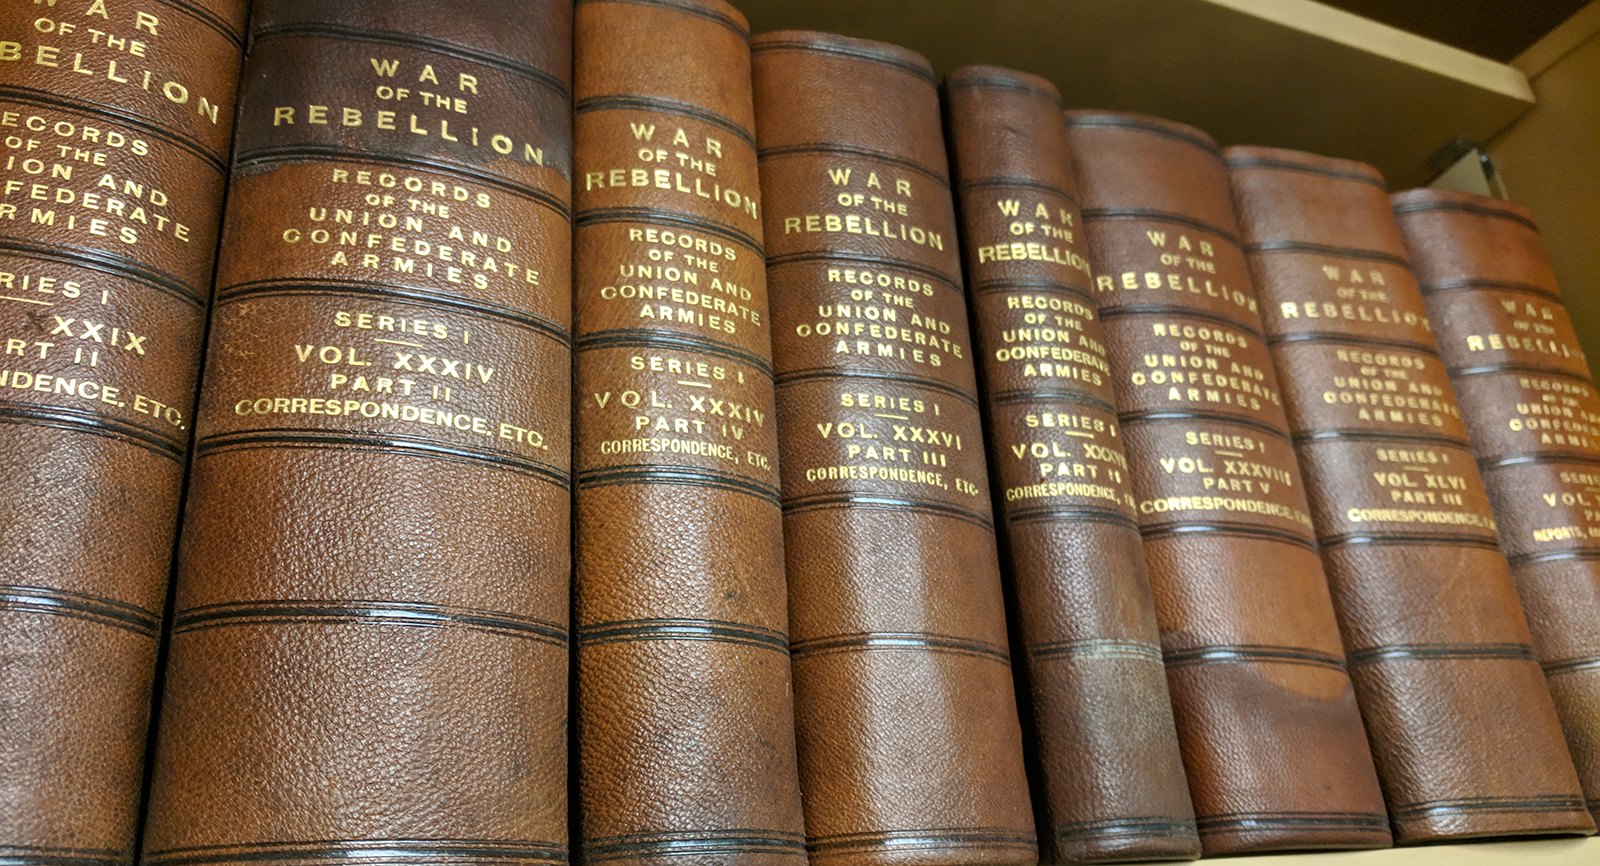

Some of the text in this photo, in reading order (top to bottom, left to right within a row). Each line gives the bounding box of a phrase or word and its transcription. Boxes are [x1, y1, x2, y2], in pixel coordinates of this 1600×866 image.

[34, 18, 146, 57] OF THE
[370, 58, 479, 95] WAR
[376, 86, 468, 114] OF THE
[273, 105, 544, 167] REBELLION
[630, 122, 722, 158] WAR
[5, 136, 107, 167] OF THE
[638, 148, 717, 177] OF THE
[98, 173, 168, 207] AND
[332, 168, 491, 208] RECORDS
[586, 168, 758, 219] REBELLION
[828, 168, 912, 197] WAR
[365, 193, 450, 219] OF THE
[837, 192, 909, 217] OF THE
[309, 207, 511, 253] UNION AND
[784, 214, 943, 251] REBELLION
[1009, 221, 1074, 244] OF THE
[1146, 230, 1214, 257] WAR
[282, 228, 540, 285] CONFEDERATE
[629, 228, 737, 261] RECORDS
[331, 250, 489, 290] ARMIES
[648, 249, 718, 273] OF THE
[1160, 252, 1217, 275] OF THE
[1322, 264, 1386, 286] WAR
[620, 264, 752, 301] UNION AND
[828, 269, 934, 297] RECORDS
[101, 290, 108, 305] I
[600, 285, 761, 327] CONFEDERATE
[850, 289, 914, 309] OF THE
[1007, 295, 1094, 321] RECORDS
[334, 311, 469, 345] SERIES I
[639, 304, 736, 335] ARMIES
[818, 304, 950, 335] UNION AND
[1024, 312, 1083, 332] OF THE
[51, 316, 146, 355] XXIX
[796, 321, 963, 359] CONFEDERATE
[1002, 328, 1106, 357] UNION AND
[1152, 322, 1248, 349] RECORDS
[1179, 340, 1231, 359] OF THE
[74, 347, 98, 367] II
[295, 344, 494, 384] VOL. XXXIV
[836, 340, 942, 367] ARMIES
[630, 356, 744, 384] SERIES I
[1023, 362, 1103, 387] ARMIES
[1144, 354, 1265, 382] UNION AND
[330, 373, 451, 401] PART II
[1131, 370, 1281, 407] CONFEDERATE
[1168, 386, 1261, 411] ARMIES
[134, 394, 186, 430] ETC.
[594, 390, 765, 427] VOL. XXXIV
[841, 392, 940, 416] SERIES I
[234, 397, 549, 450] CORRESPONDENCE, ETC.
[635, 415, 743, 440] PART IV
[817, 422, 962, 451] VOL. XXXVI
[1025, 412, 1117, 438] SERIES I
[601, 438, 772, 471] CORRESPONDENCE, ETC.
[1011, 442, 1072, 460] VOL.
[1185, 430, 1255, 451] SERIES
[848, 444, 947, 467] PART III
[1160, 457, 1215, 474] VOL.
[806, 465, 979, 496] CORRESPONDENCE, ETC.
[1040, 461, 1122, 484] PART II
[1203, 477, 1271, 495] PART V
[1424, 474, 1468, 491] XLVI
[1006, 482, 1122, 506] CORRESPONDENCE,
